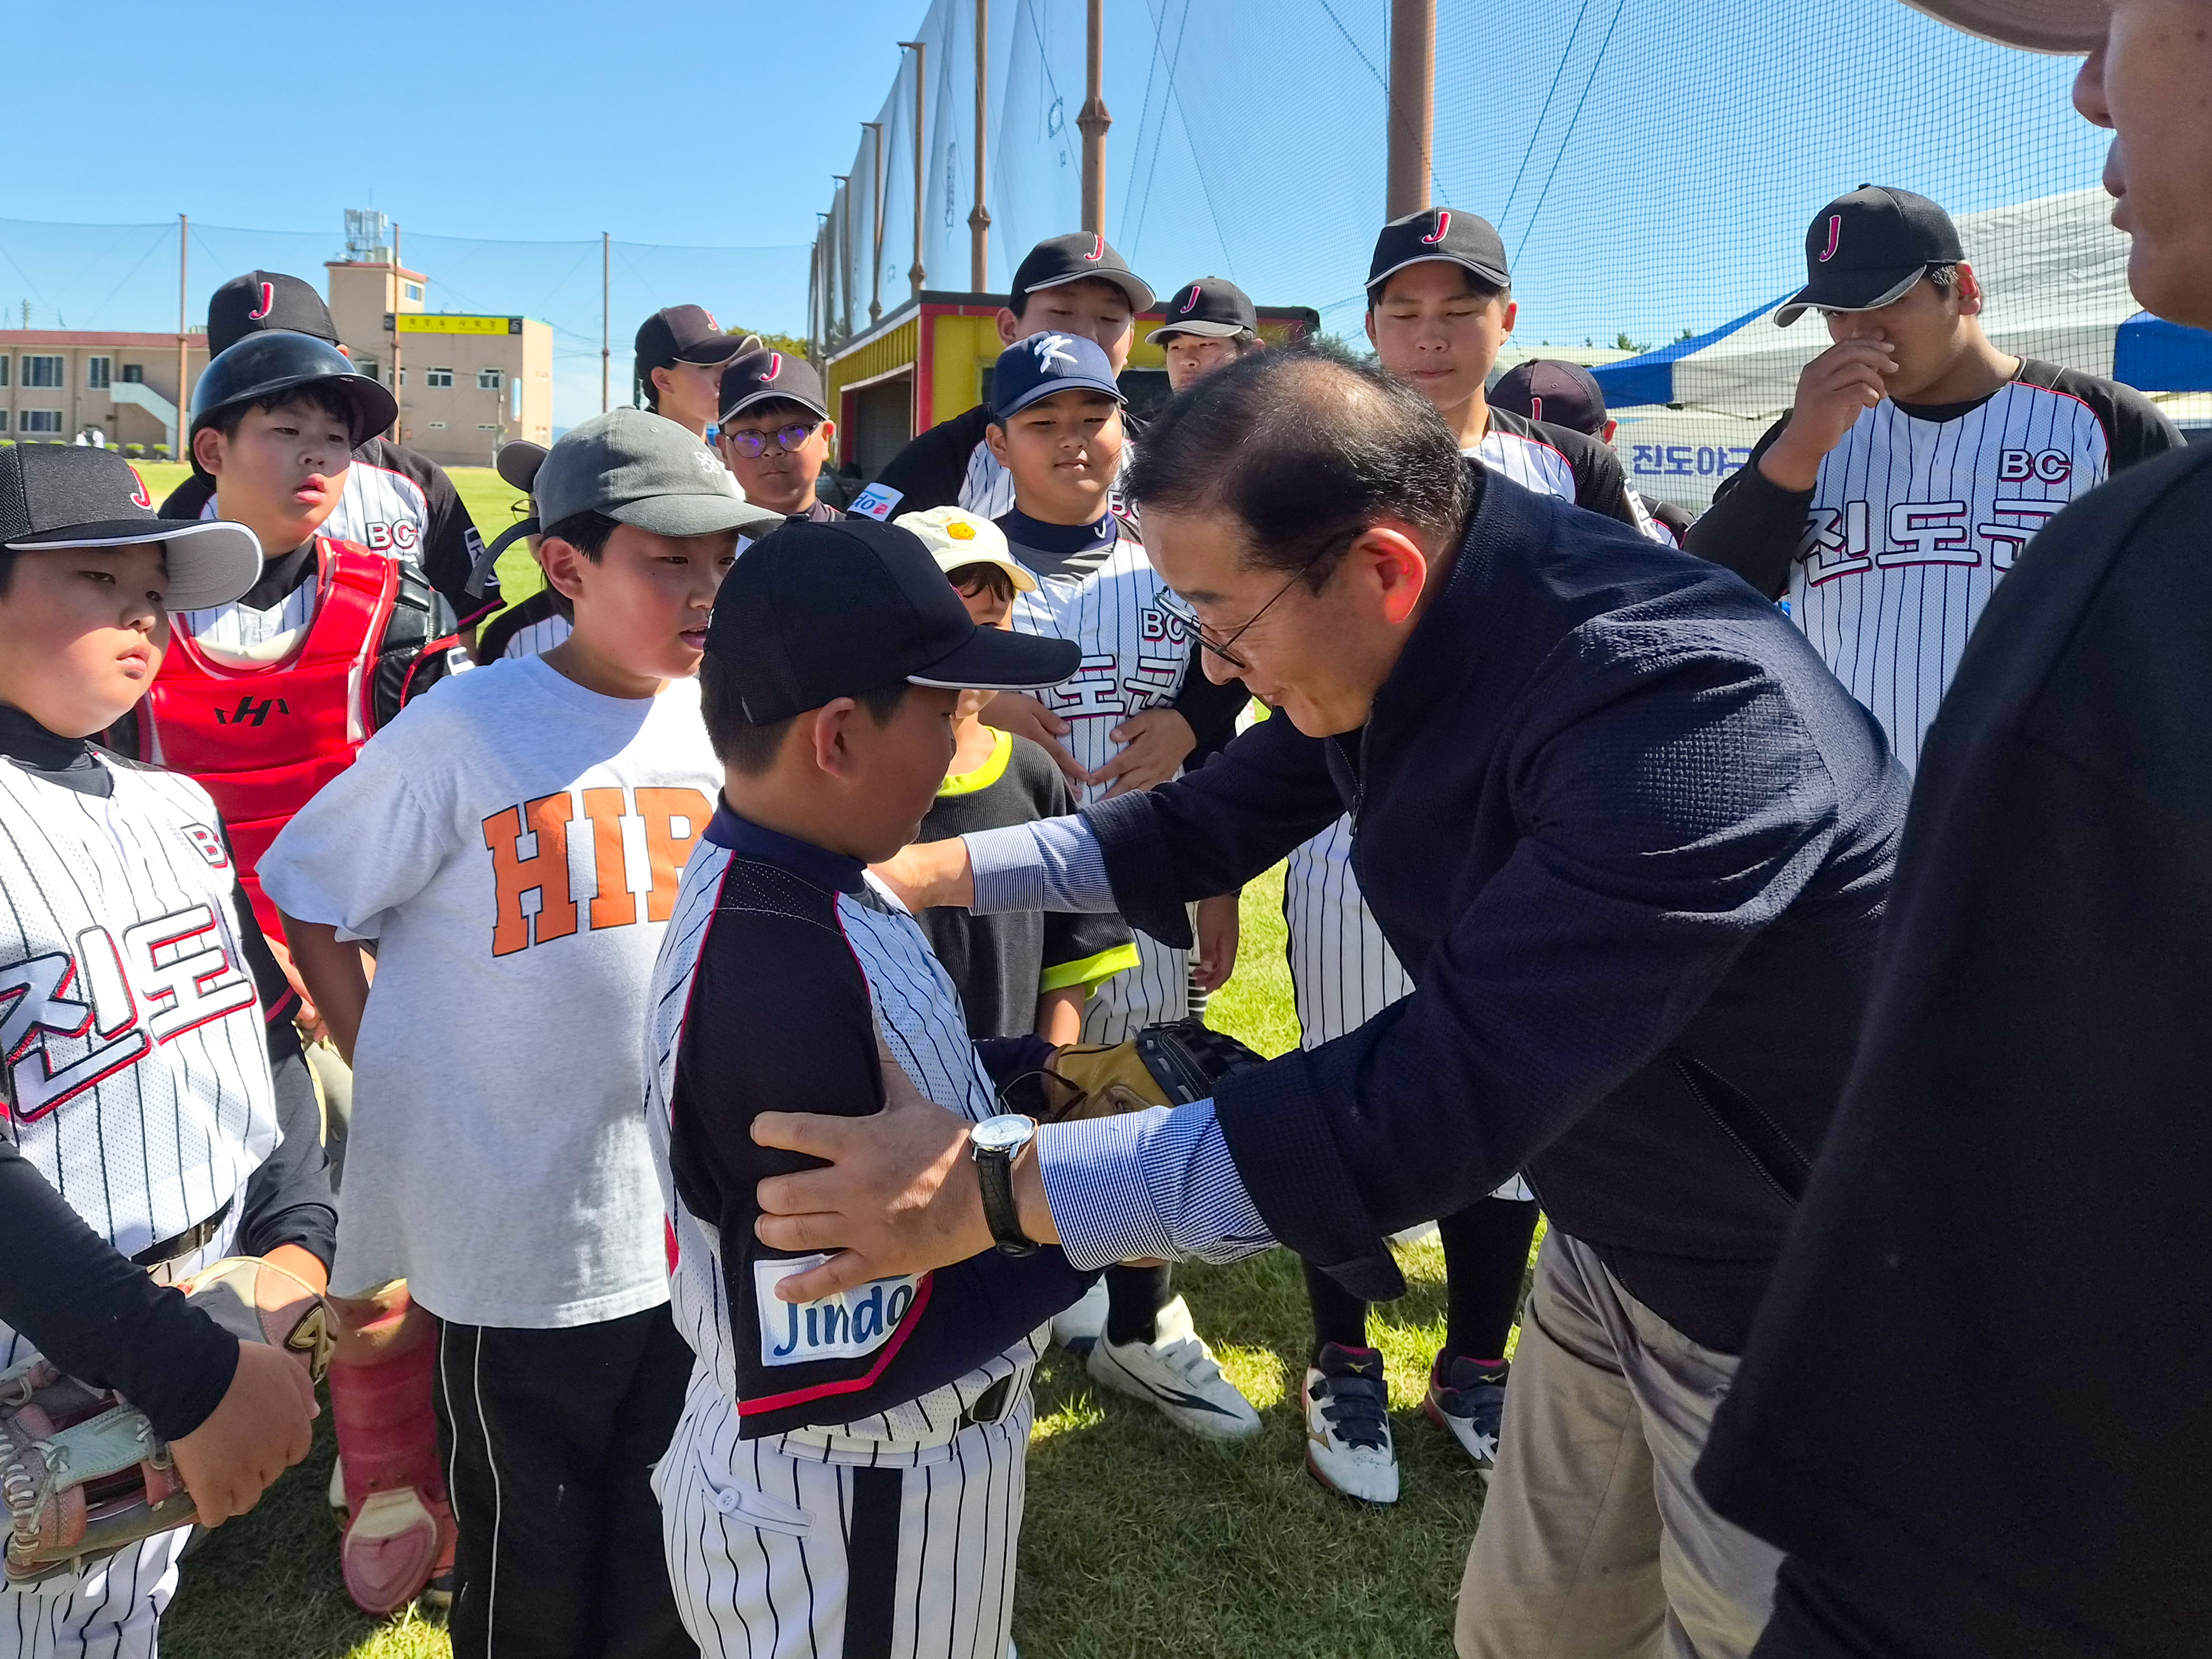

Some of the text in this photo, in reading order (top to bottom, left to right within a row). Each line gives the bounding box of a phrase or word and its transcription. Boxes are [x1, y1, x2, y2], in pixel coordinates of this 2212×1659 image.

[1421, 211, 1452, 244] J
[1819, 214, 1841, 263] J
[1083, 234, 1104, 261] J
[249, 281, 274, 320] J
[1180, 285, 1201, 314] J
[758, 353, 782, 382] J
[1998, 448, 2071, 483] BC
[130, 466, 152, 510] J
[366, 519, 418, 550] BC
[1141, 608, 1186, 645] BC
[1037, 654, 1184, 721] 도군
[0, 903, 257, 1123] 진도
[773, 1285, 912, 1356] Jindo
